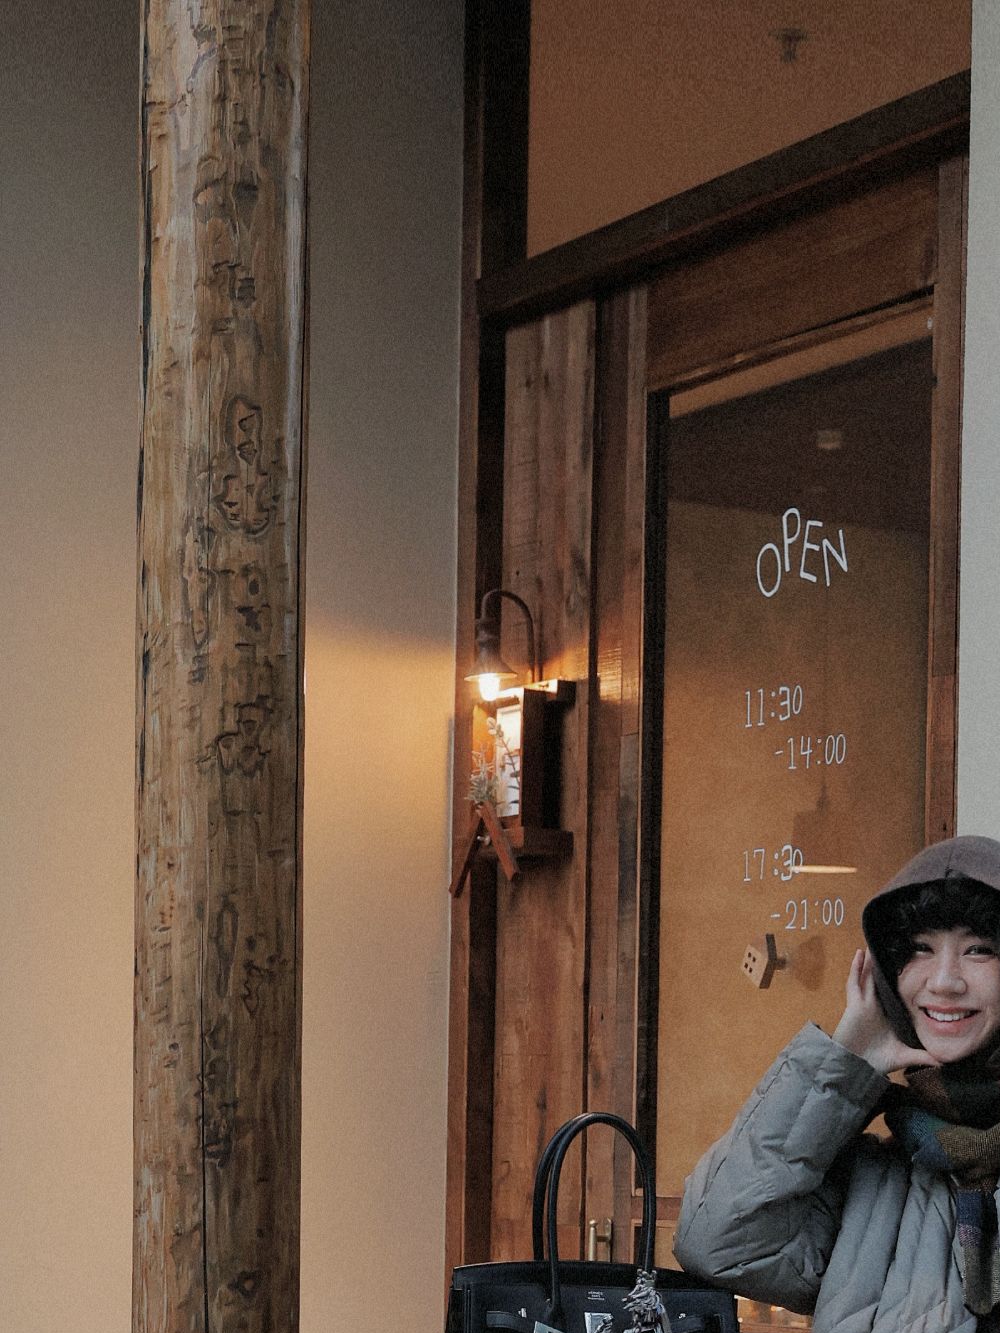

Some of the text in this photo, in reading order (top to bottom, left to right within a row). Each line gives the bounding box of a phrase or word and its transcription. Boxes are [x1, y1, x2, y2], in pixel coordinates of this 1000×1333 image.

[756, 507, 848, 598] OPEN
[745, 685, 803, 728] 11:30
[775, 734, 846, 769] -14:00
[743, 844, 803, 882] 17:30
[770, 899, 844, 930] -21:00
